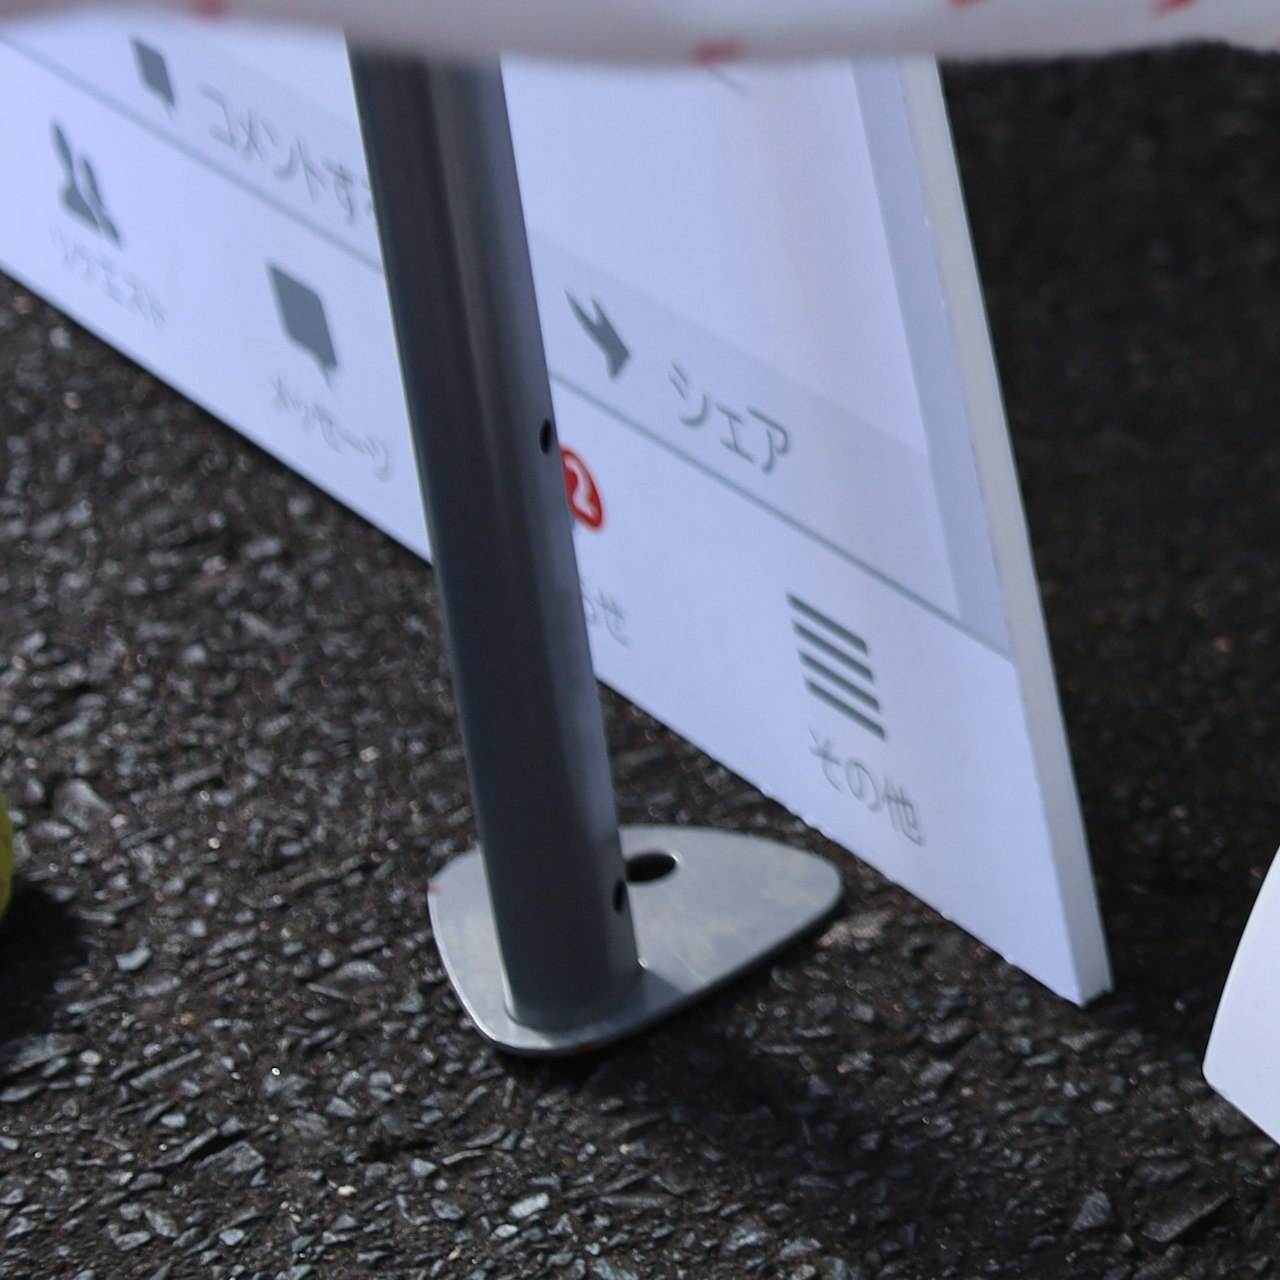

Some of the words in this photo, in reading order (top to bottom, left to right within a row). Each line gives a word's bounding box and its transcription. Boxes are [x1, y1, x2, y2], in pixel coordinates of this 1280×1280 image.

[667, 360, 790, 475] シェア
[808, 728, 925, 846] その他
